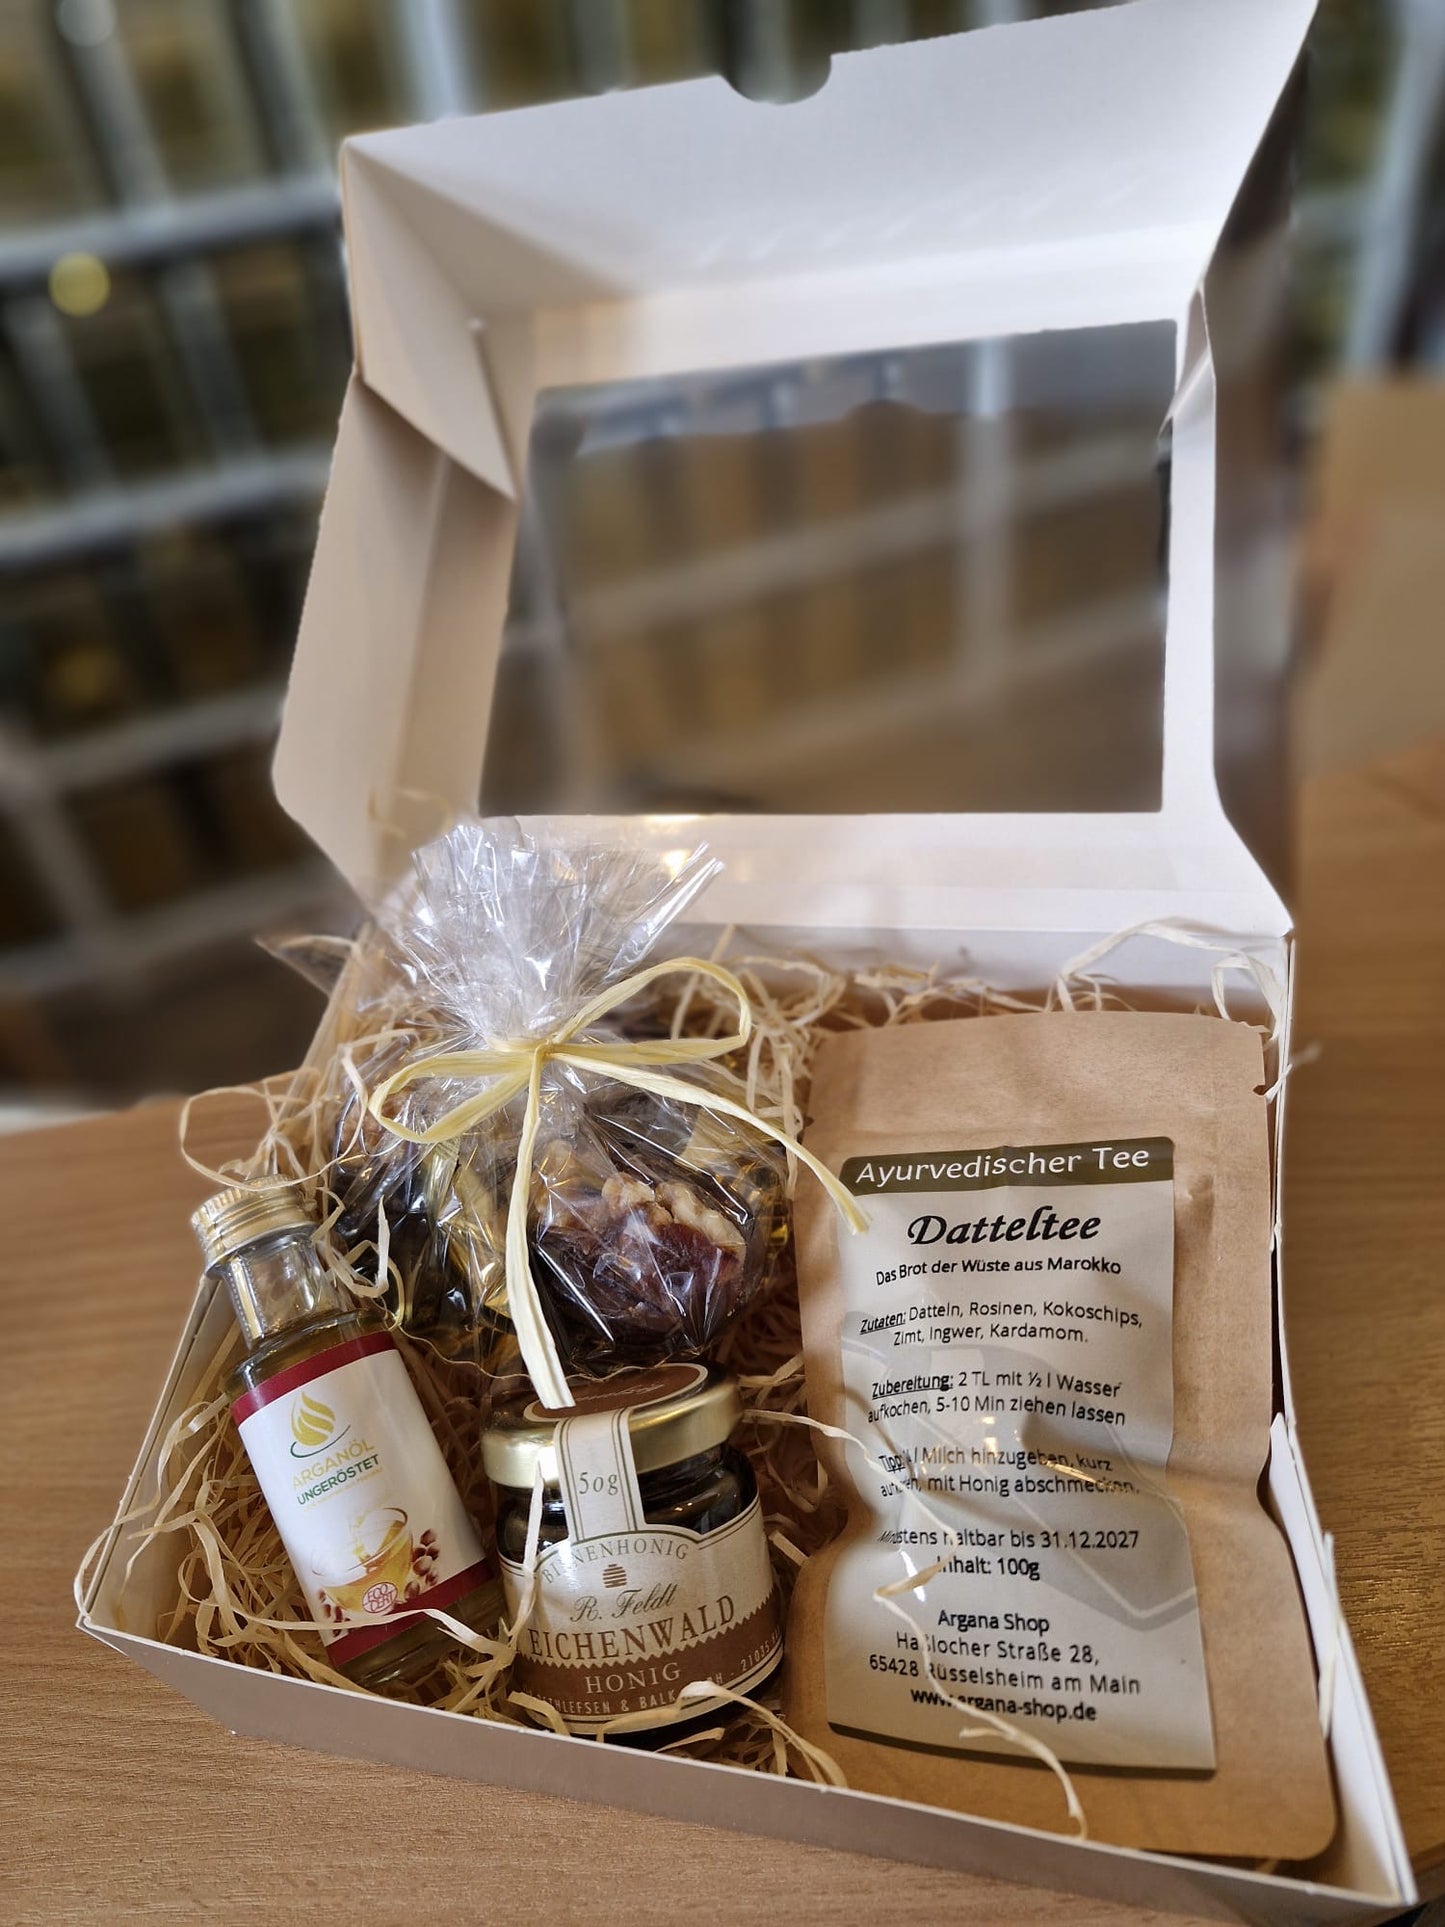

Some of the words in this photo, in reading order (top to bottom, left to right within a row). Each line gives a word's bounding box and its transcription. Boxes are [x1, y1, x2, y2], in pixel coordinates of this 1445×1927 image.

[855, 1151, 1082, 1187] Ayurvedischer
[1092, 1146, 1150, 1170] Tee
[907, 1205, 1101, 1245] Datteltee
[876, 1267, 897, 1286] Das
[899, 1258, 928, 1277] Brot
[931, 1259, 958, 1274] der
[961, 1258, 1011, 1273] Wüste
[1014, 1258, 1043, 1272] aus
[1047, 1256, 1122, 1275] Marokko
[860, 1311, 907, 1335] Zutaten:
[908, 1302, 964, 1321] Datteln,
[969, 1302, 1038, 1317] Rosinen,
[1042, 1301, 1143, 1329] Kokoschips,
[893, 1329, 926, 1346] Zimt,
[930, 1325, 984, 1343] Ingwer,
[990, 1323, 1089, 1344] Kardamom.
[871, 1373, 954, 1400] Zubereitung:
[958, 1372, 967, 1387] 2
[972, 1371, 990, 1387] TL
[996, 1370, 1022, 1387] mit
[1056, 1374, 1122, 1398] Wasser
[868, 1397, 931, 1424] aufkochen,
[935, 1395, 970, 1412] 5-10
[974, 1396, 1005, 1412] Min
[1010, 1396, 1066, 1417] ziehen
[1071, 1400, 1126, 1426] lassen
[292, 1438, 376, 1491] ARGANÖL
[922, 1447, 965, 1464] Milch
[971, 1447, 1074, 1470] hinzugeben,
[1076, 1453, 1113, 1472] kurz
[296, 1453, 380, 1505] UNGERÖSTET
[927, 1475, 955, 1492] mit
[959, 1474, 1010, 1498] Honig
[1010, 1529, 1035, 1548] bis
[1040, 1530, 1139, 1549] 31.12.2027
[542, 1537, 690, 1585] BINENHONIG
[997, 1557, 1040, 1581] 100g
[570, 1594, 603, 1623] R.
[611, 1583, 679, 1619] Feldt
[528, 1594, 736, 1661] EICHENWALD
[937, 1609, 999, 1632] Argana
[1004, 1612, 1050, 1635] Shop
[997, 1639, 1061, 1662] Straße
[1069, 1645, 1100, 1666] 28,
[585, 1661, 682, 1694] HONIG
[869, 1653, 919, 1677] 65428
[1051, 1675, 1082, 1692] am
[1090, 1674, 1141, 1695] Main
[620, 1699, 631, 1714] &
